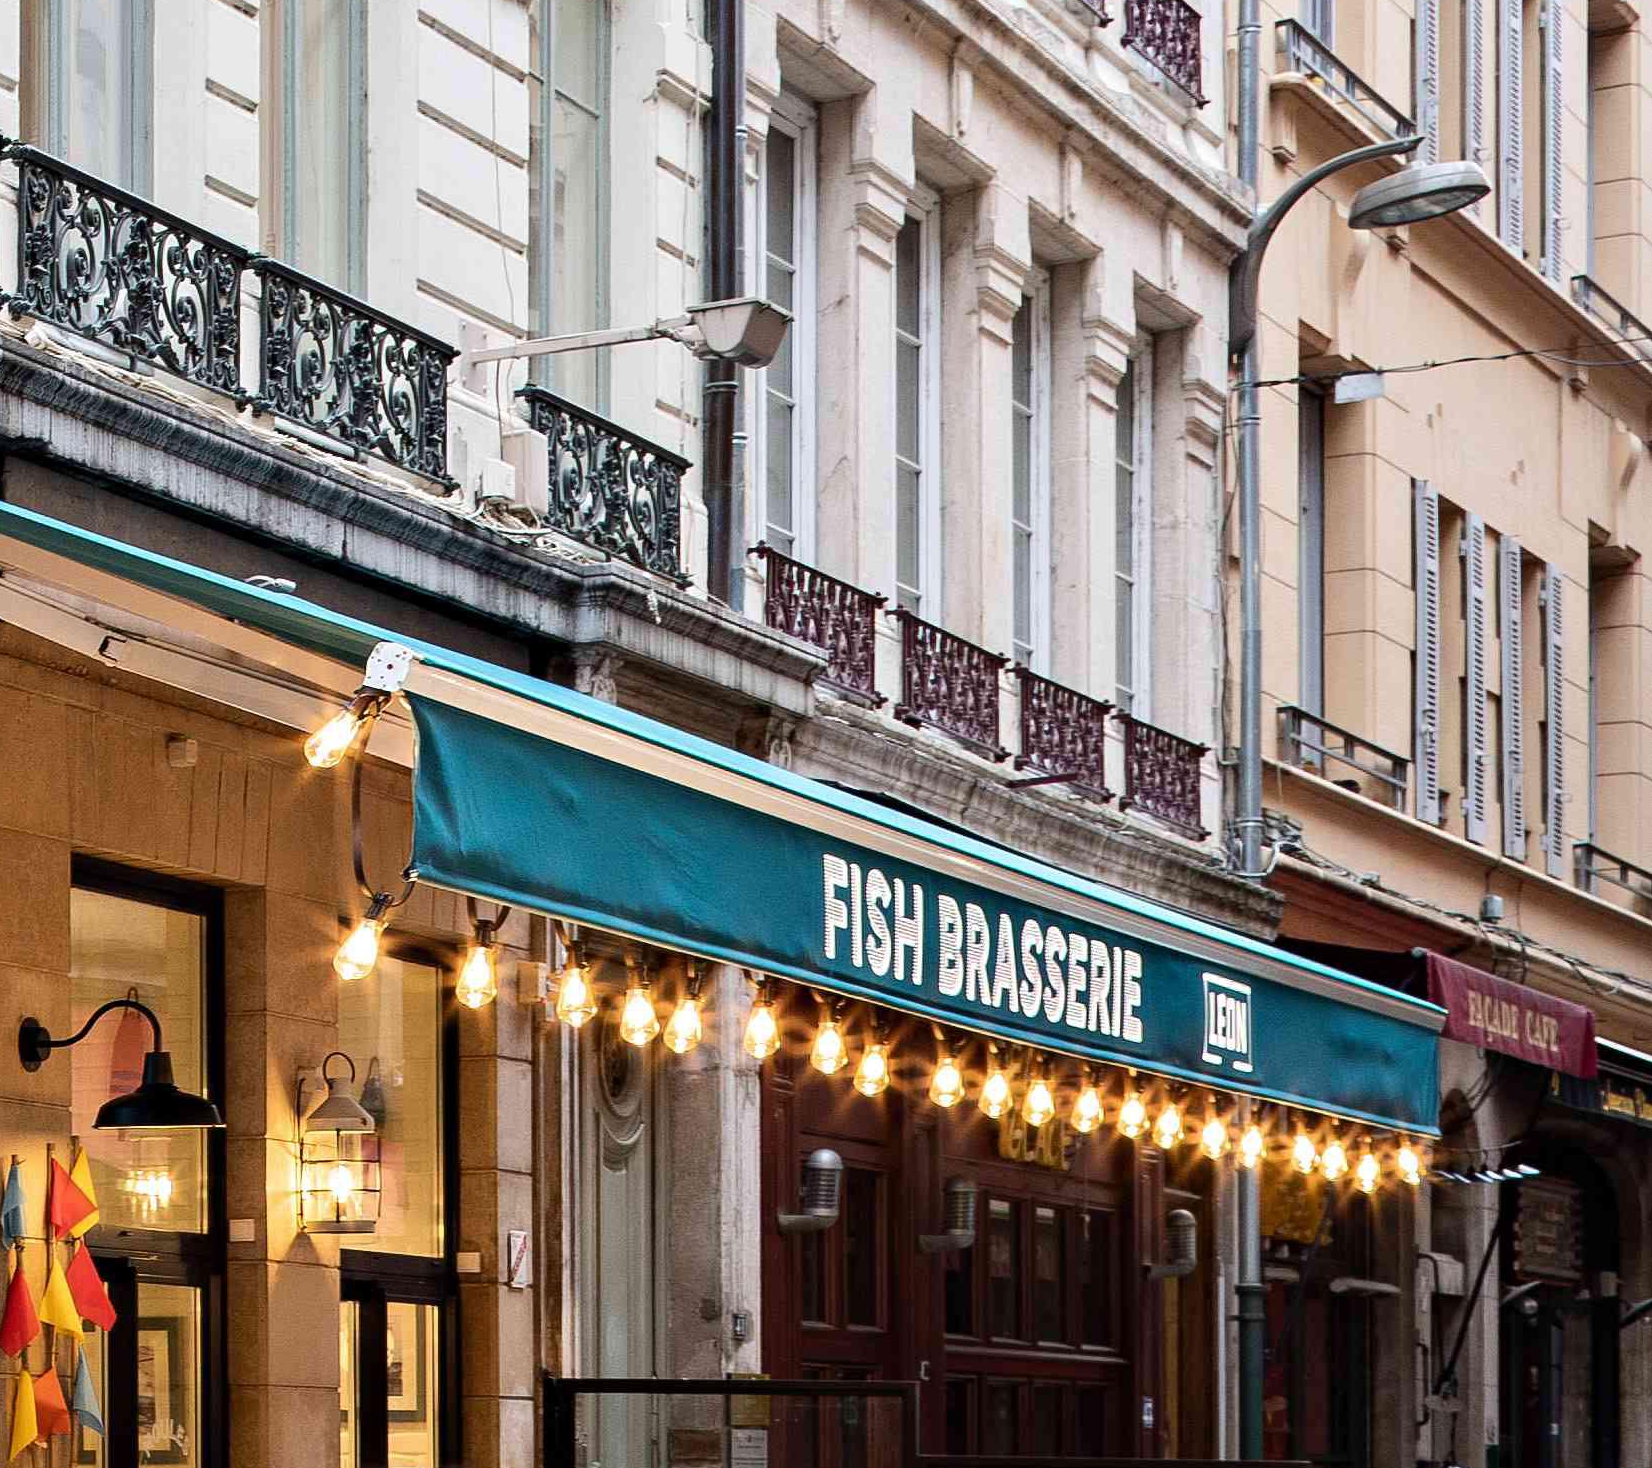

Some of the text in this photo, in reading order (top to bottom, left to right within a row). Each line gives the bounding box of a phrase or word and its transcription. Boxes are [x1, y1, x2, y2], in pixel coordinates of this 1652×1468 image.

[822, 853, 1145, 1044] FISH BRASSERIE
[1207, 989, 1249, 1056] LÉON
